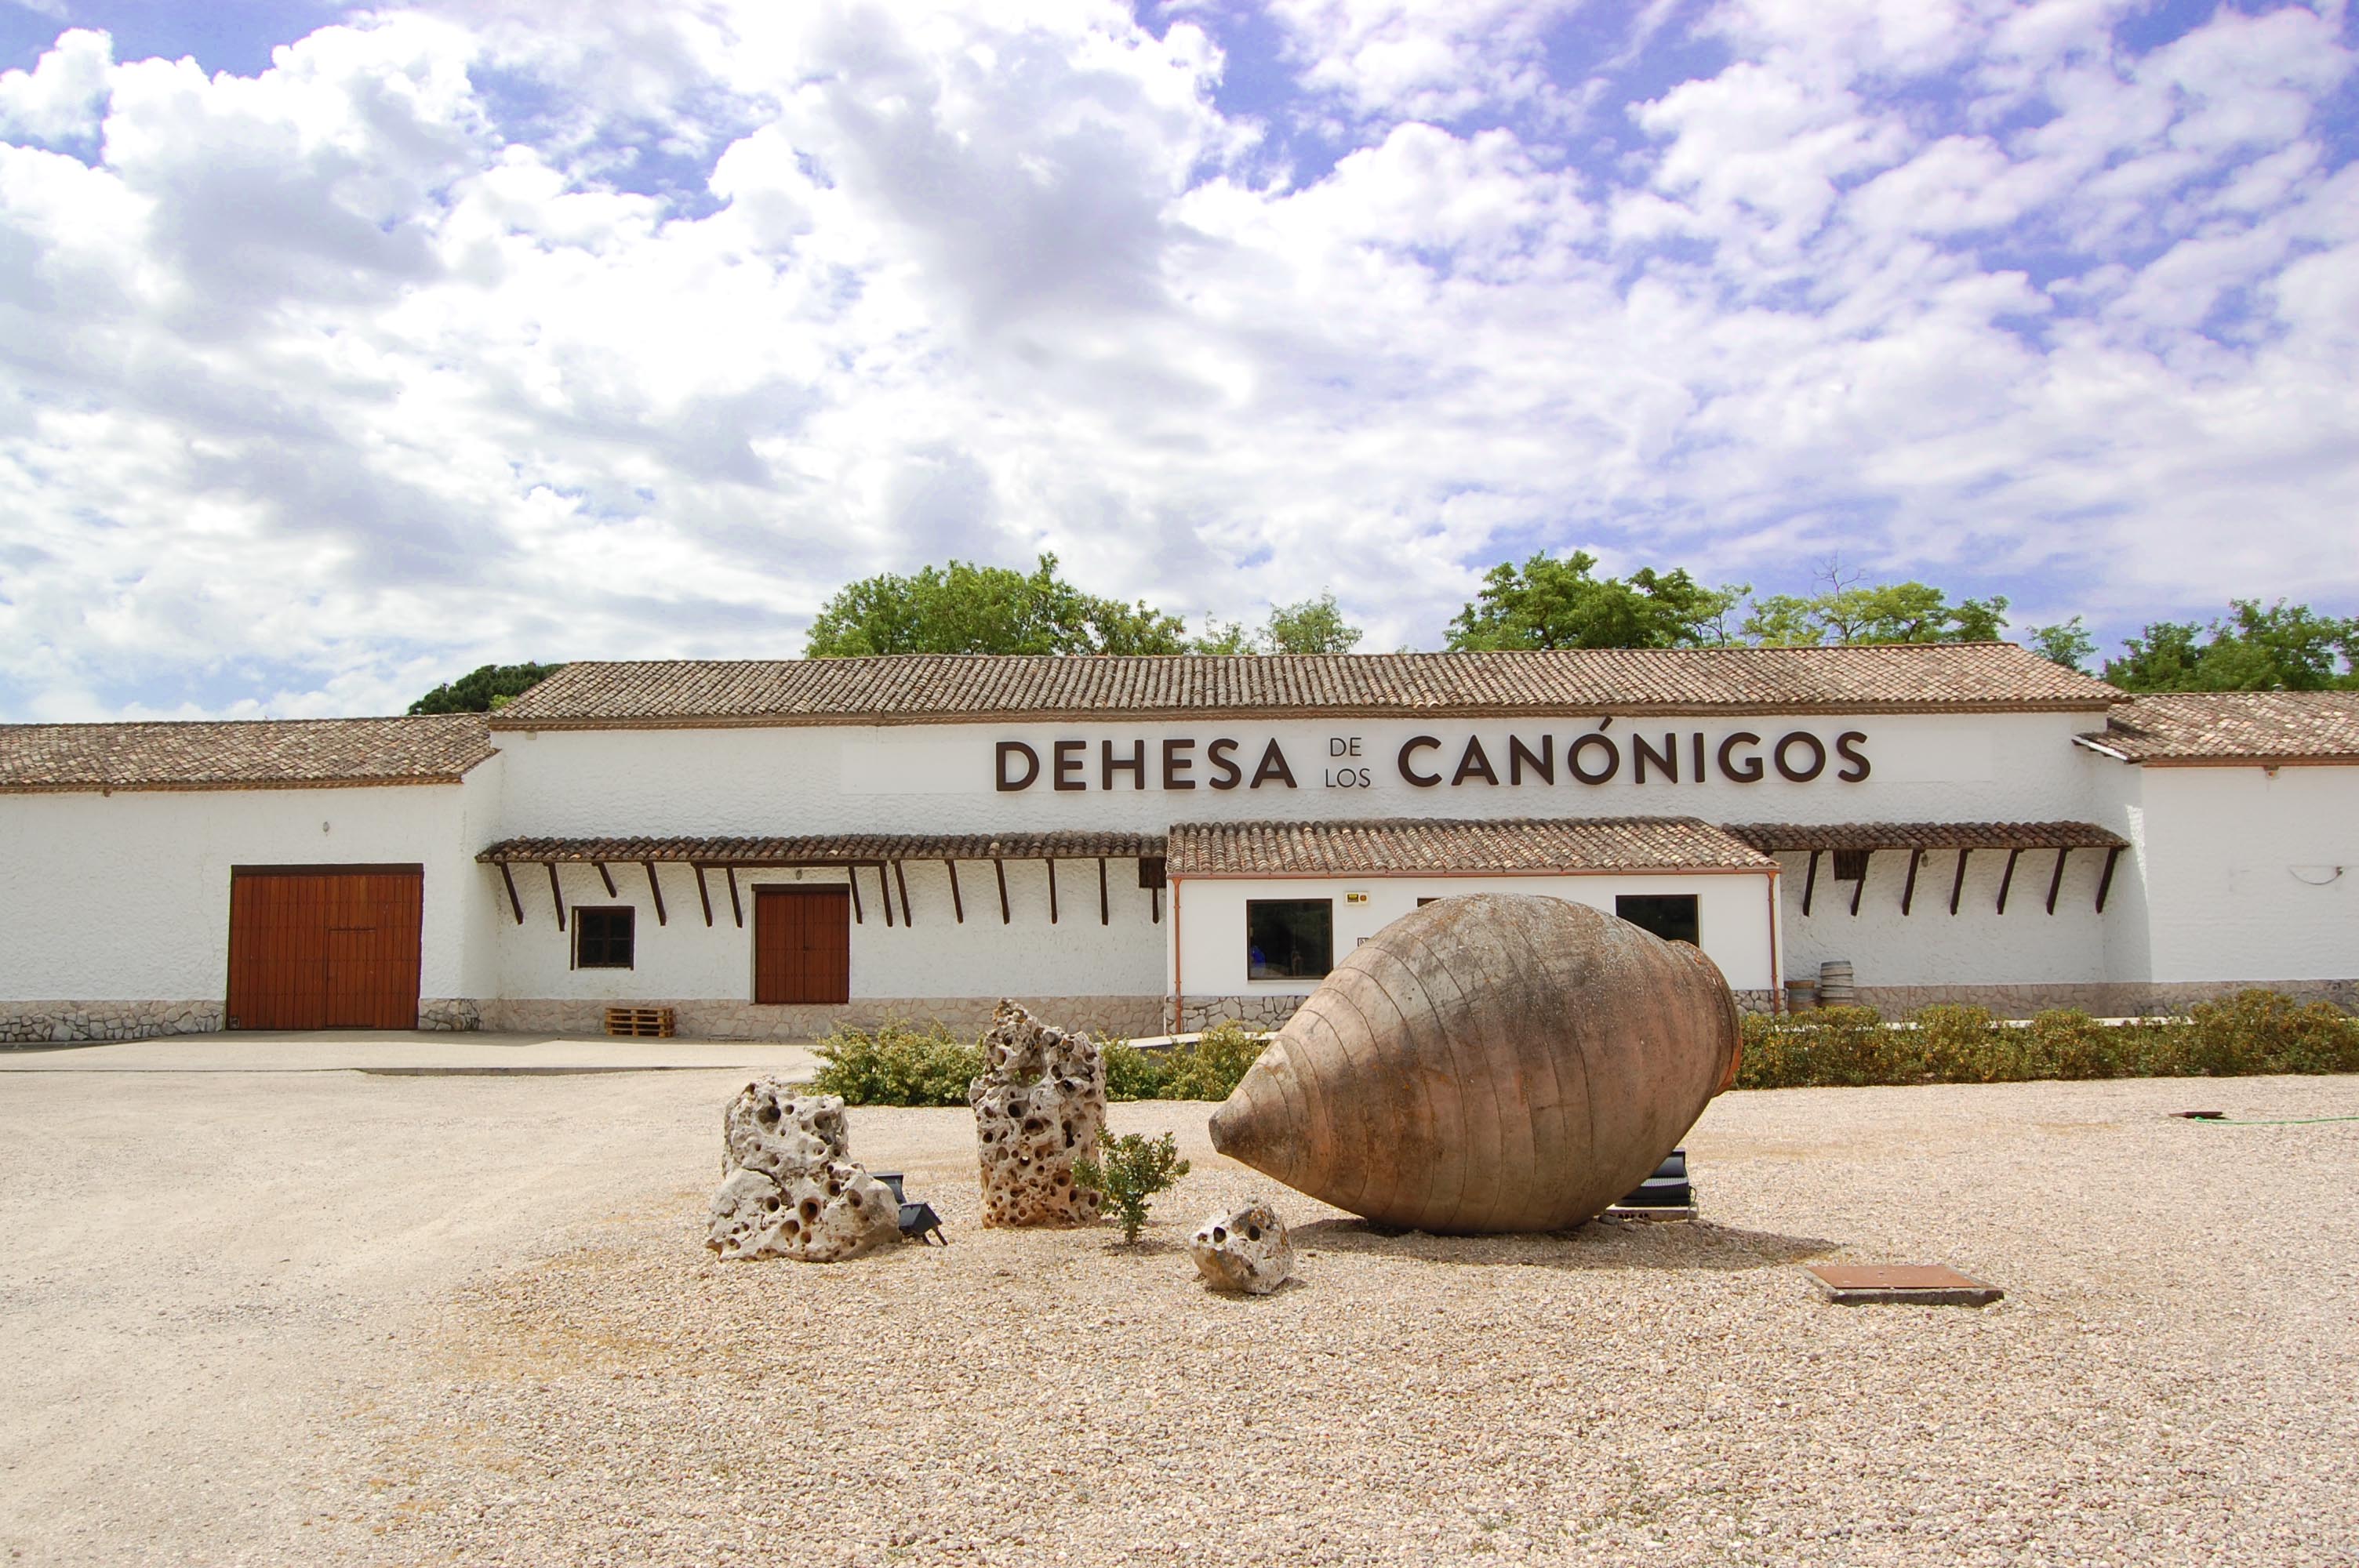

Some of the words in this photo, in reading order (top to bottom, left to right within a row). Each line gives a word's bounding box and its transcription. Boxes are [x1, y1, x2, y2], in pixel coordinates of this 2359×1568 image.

[995, 737, 1298, 792] DEHESA
[1329, 737, 1362, 757] DE
[1397, 715, 1871, 788] CANÓNIGOS
[1325, 768, 1371, 789] LOS
